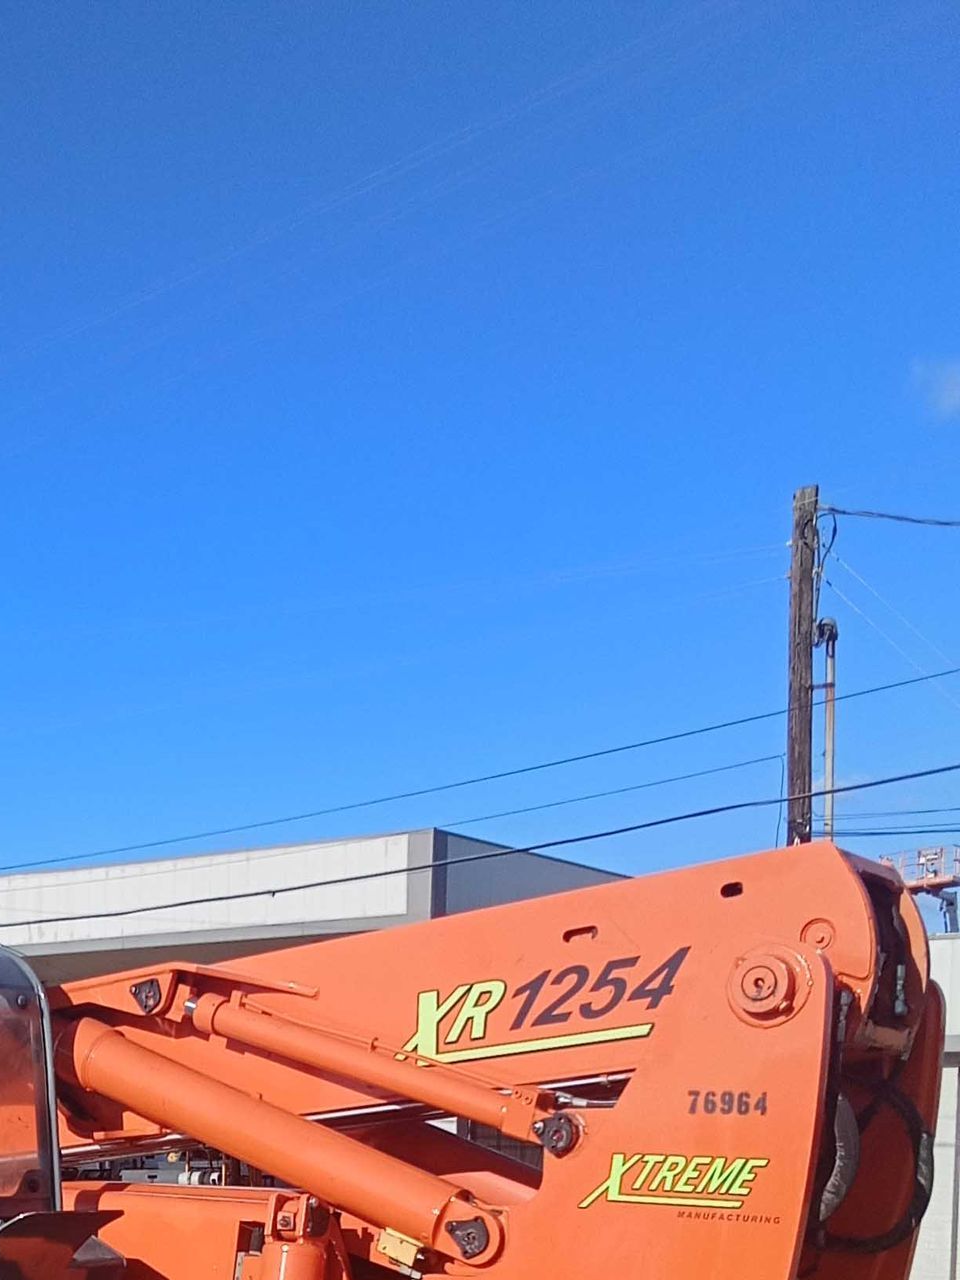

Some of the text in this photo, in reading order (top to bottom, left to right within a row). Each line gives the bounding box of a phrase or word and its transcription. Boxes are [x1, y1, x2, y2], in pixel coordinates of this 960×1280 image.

[393, 946, 691, 1067] XR 1254
[687, 1090, 768, 1116] 76964
[577, 1152, 770, 1209] XTREME
[677, 1210, 781, 1225] MANUFACTURING
